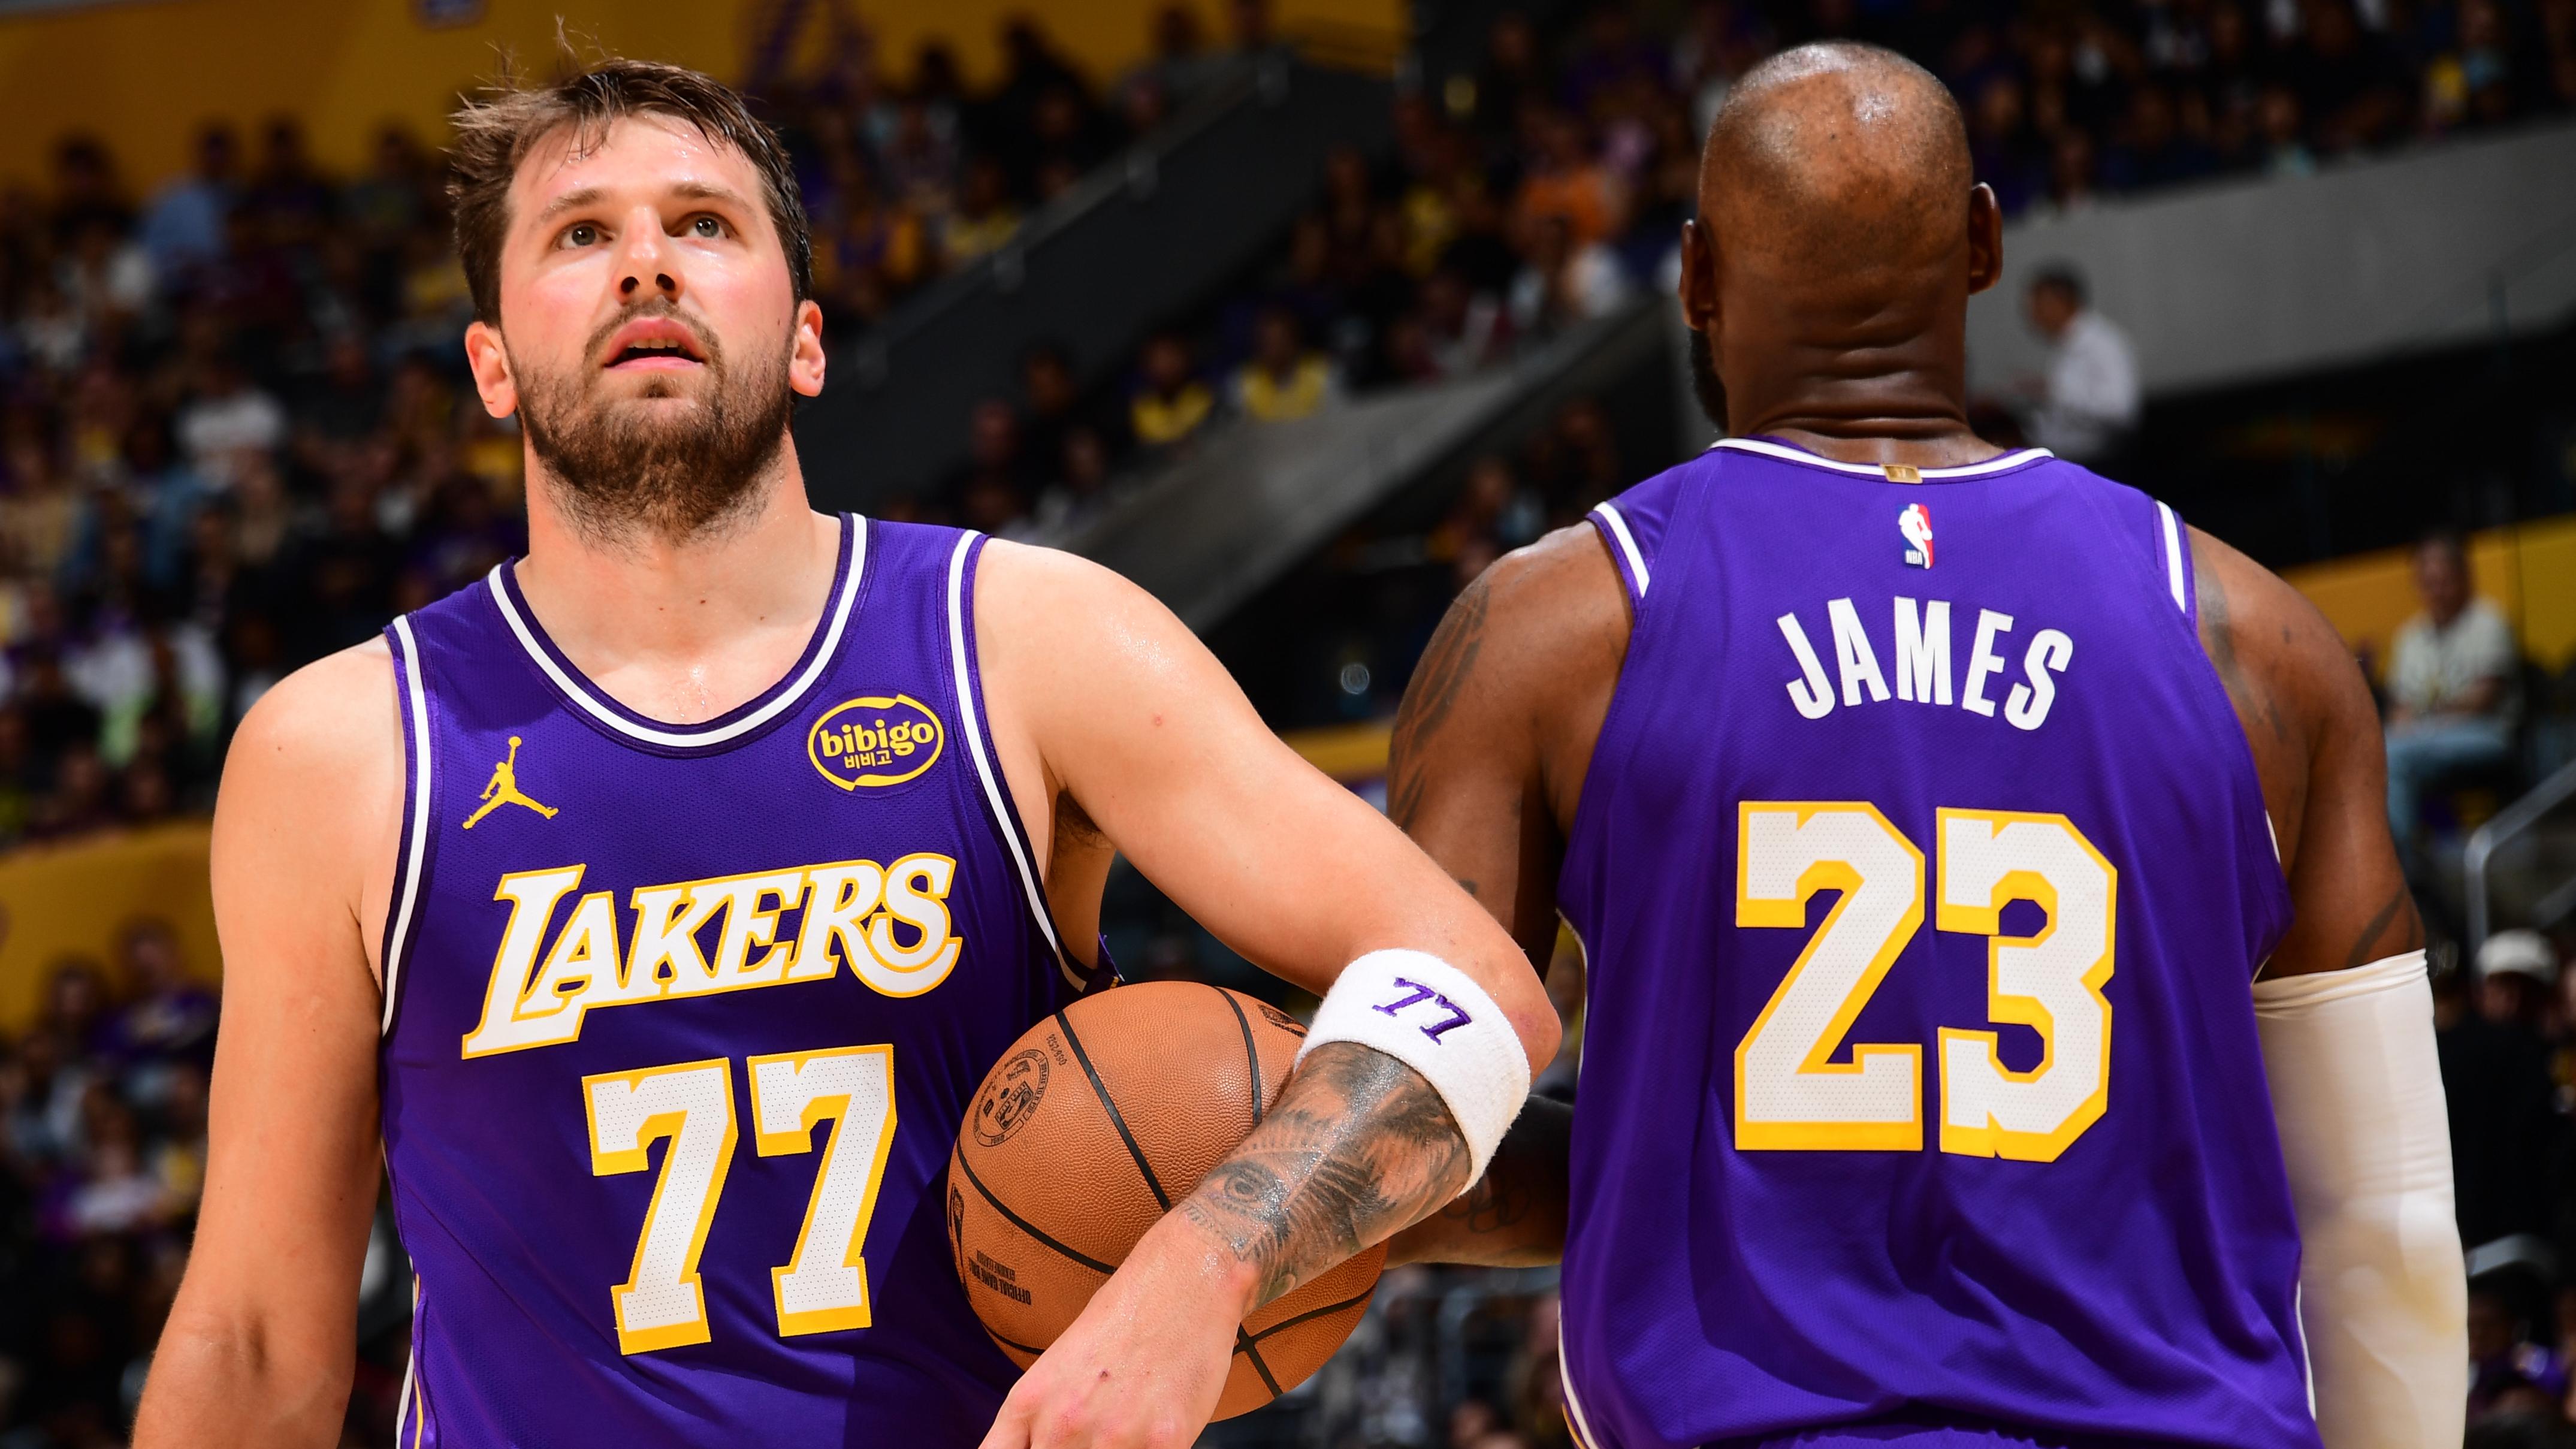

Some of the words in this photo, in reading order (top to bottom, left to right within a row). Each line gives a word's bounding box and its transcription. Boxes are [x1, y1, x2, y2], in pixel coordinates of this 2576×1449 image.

[1905, 549, 1923, 565] NBA
[1777, 596, 2074, 731] JAMES
[819, 719, 934, 757] bibigo
[844, 750, 892, 769] 비비고
[461, 852, 964, 1059] LAKERS
[1734, 801, 2118, 1163] 23
[1372, 977, 1472, 1046] 77
[581, 1043, 898, 1356] 77
